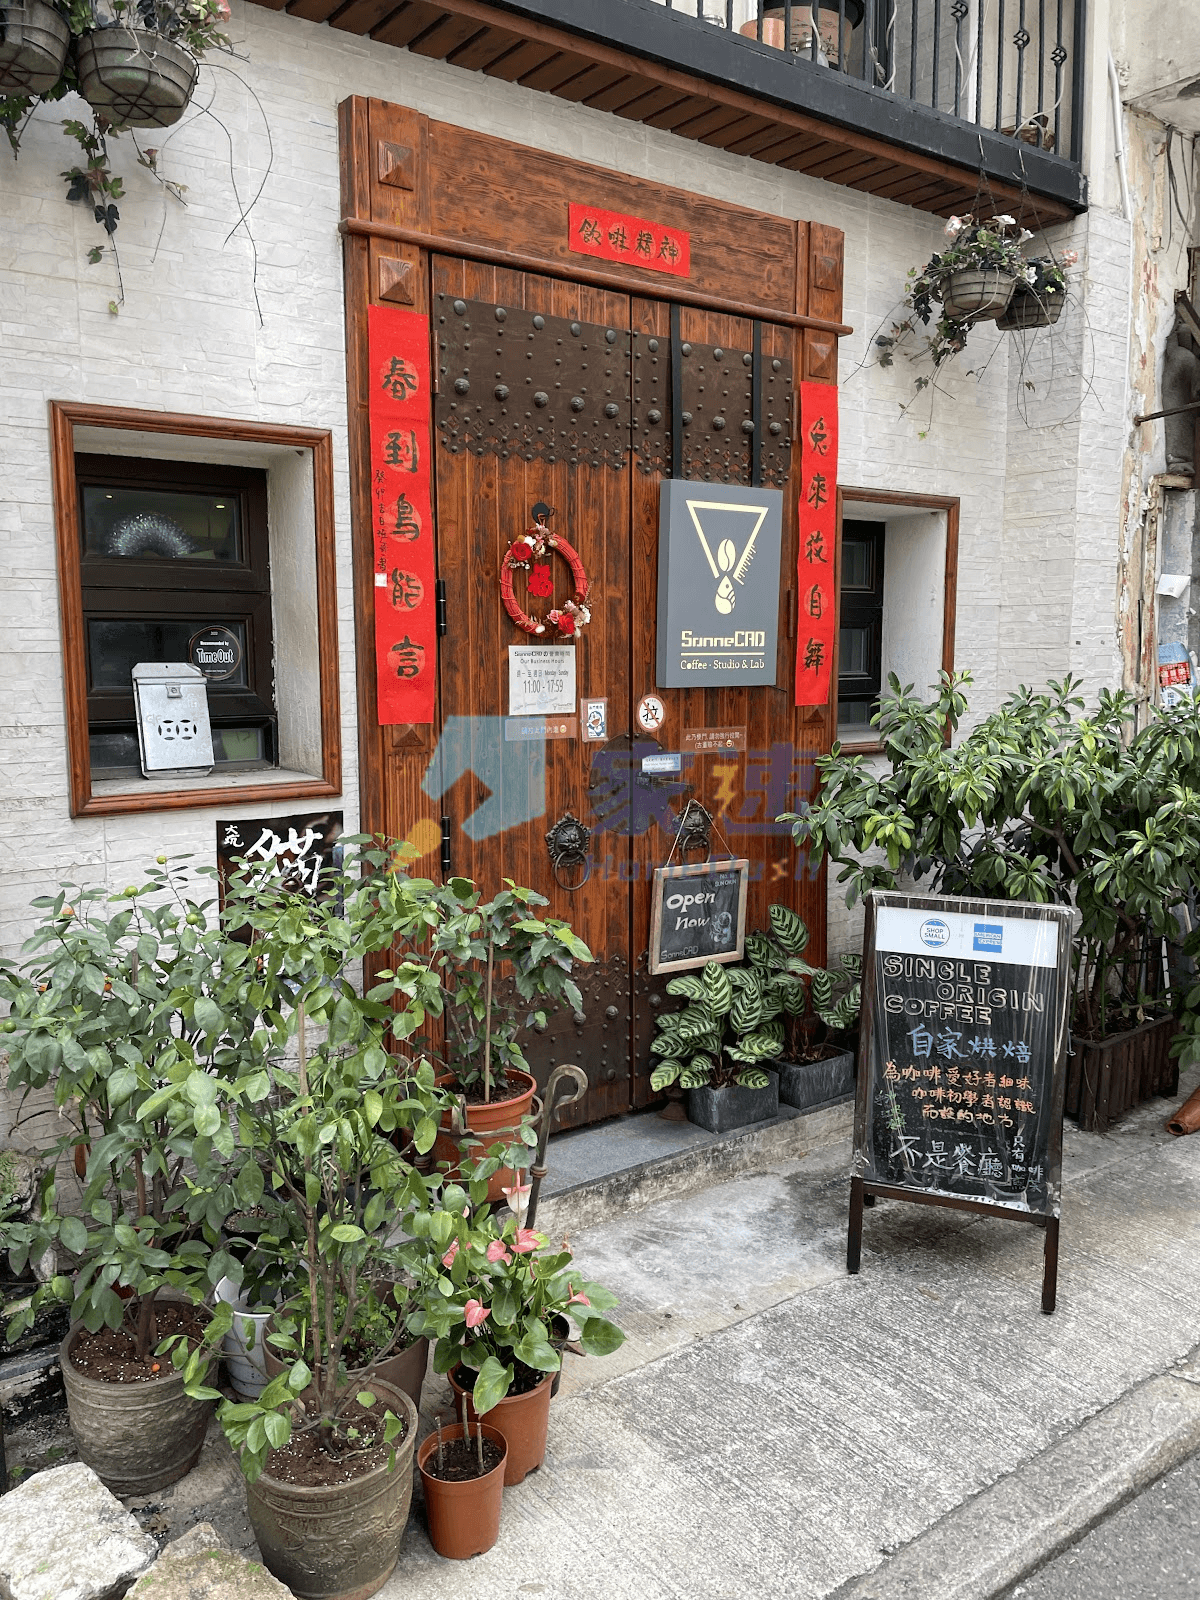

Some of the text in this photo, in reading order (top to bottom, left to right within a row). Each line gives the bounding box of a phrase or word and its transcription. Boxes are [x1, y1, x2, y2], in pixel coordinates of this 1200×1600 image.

[381, 355, 425, 678] 春到鳥能言
[680, 658, 708, 670] Coffee
[713, 658, 740, 670] Studio
[741, 658, 749, 670] &
[749, 658, 766, 670] Lab
[523, 680, 541, 694] 11:00
[547, 679, 564, 693] 17:59
[642, 702, 660, 723] 拉
[223, 824, 245, 848] 大坑
[666, 892, 716, 913] Open
[924, 932, 945, 940] SMALL
[883, 955, 992, 986] SINGLE
[883, 995, 992, 1026] COFFEE
[936, 982, 1045, 1013] ORIGIN
[906, 1022, 1033, 1064] 自家烘焙
[882, 1060, 1034, 1092] 為咖啡愛好者細味
[911, 1086, 1037, 1115] 咖啡初學者認識
[921, 1103, 1014, 1128] 而設的地方
[889, 1135, 1004, 1179] 不是餐廳
